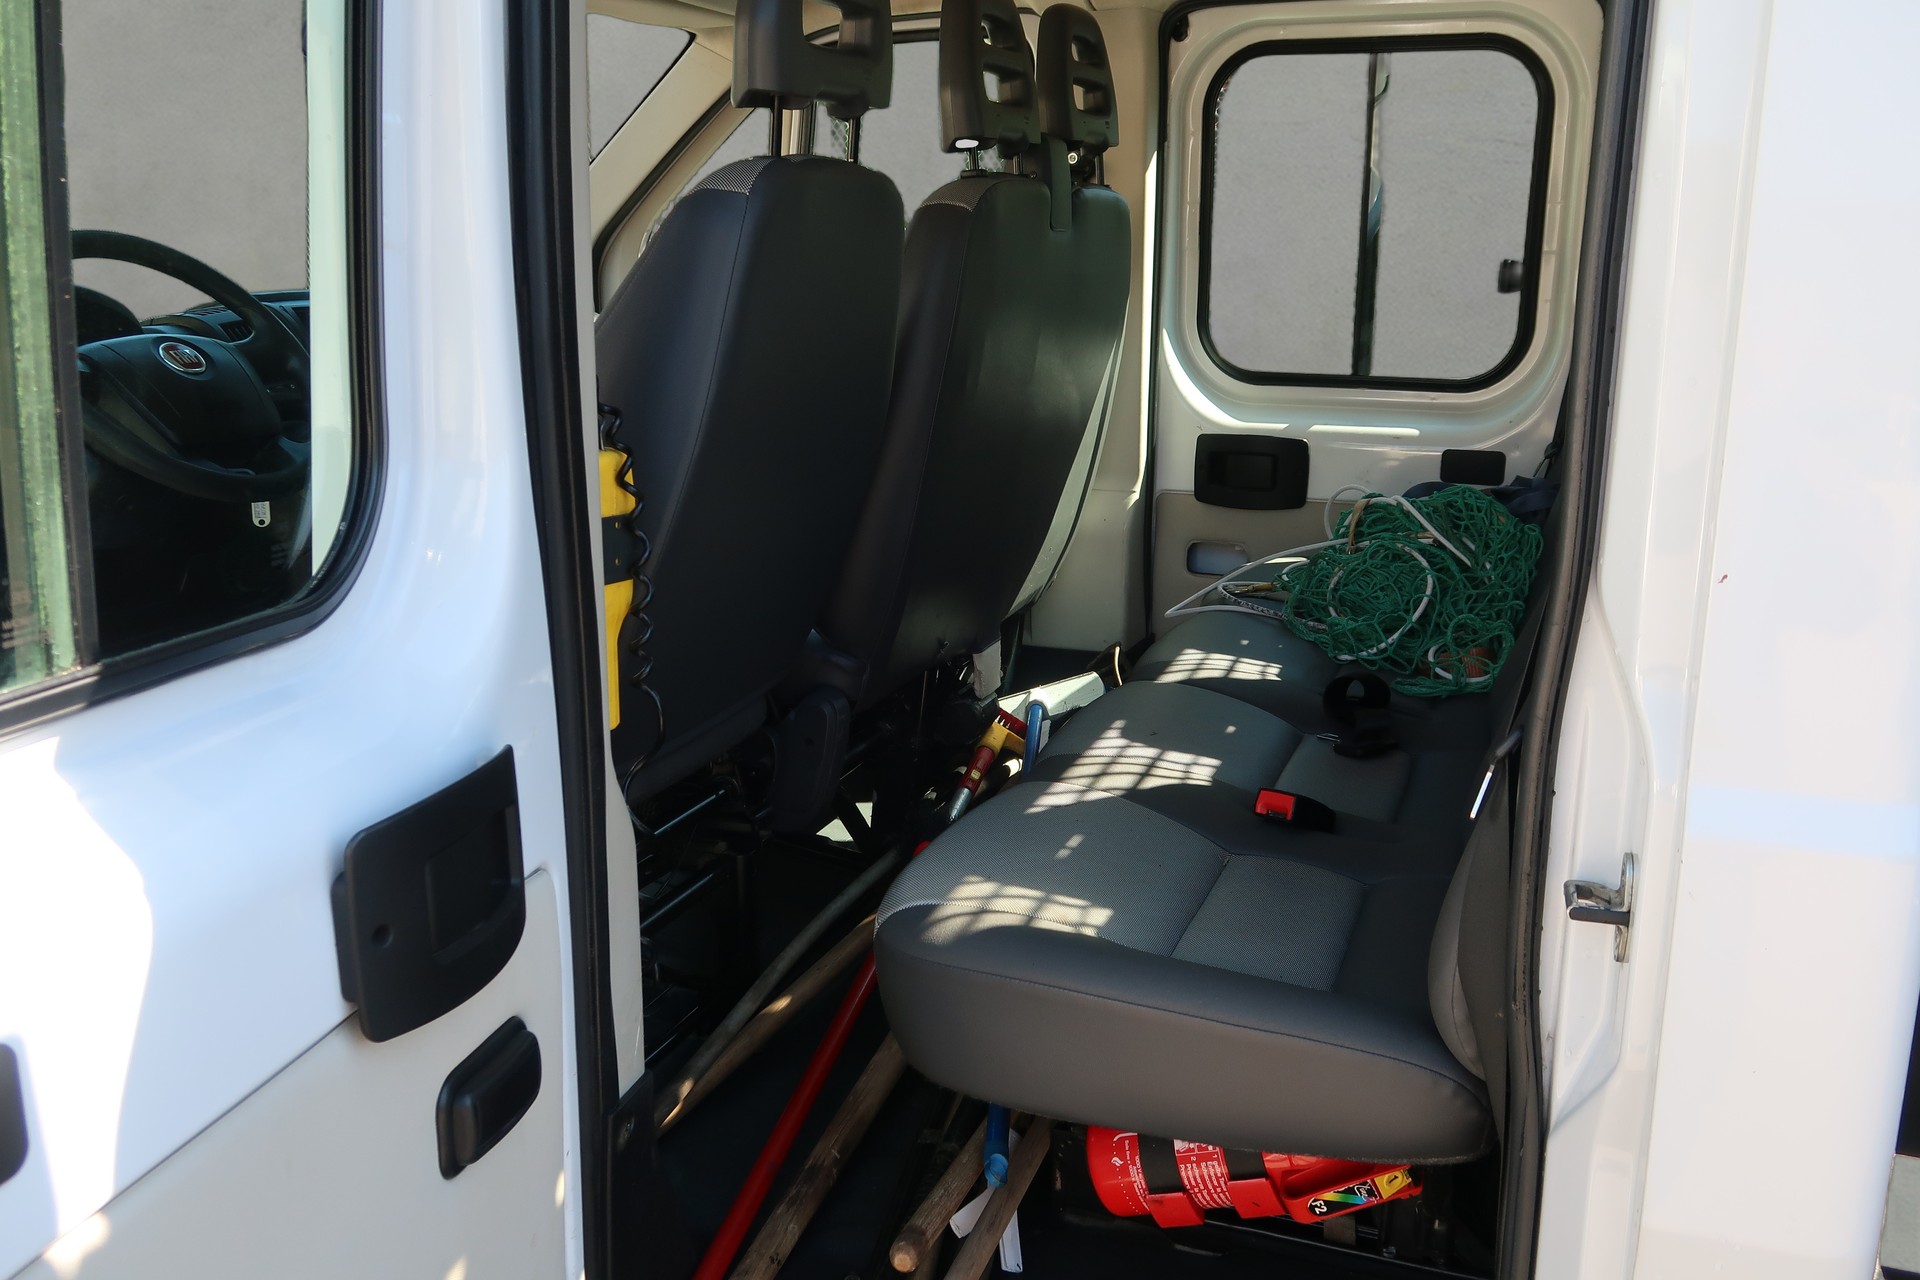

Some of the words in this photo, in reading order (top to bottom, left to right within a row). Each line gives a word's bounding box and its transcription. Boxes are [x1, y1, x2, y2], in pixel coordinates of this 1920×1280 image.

[169, 349, 199, 364] FIAT
[1388, 1175, 1399, 1184] 1
[1311, 1200, 1327, 1215] F2
